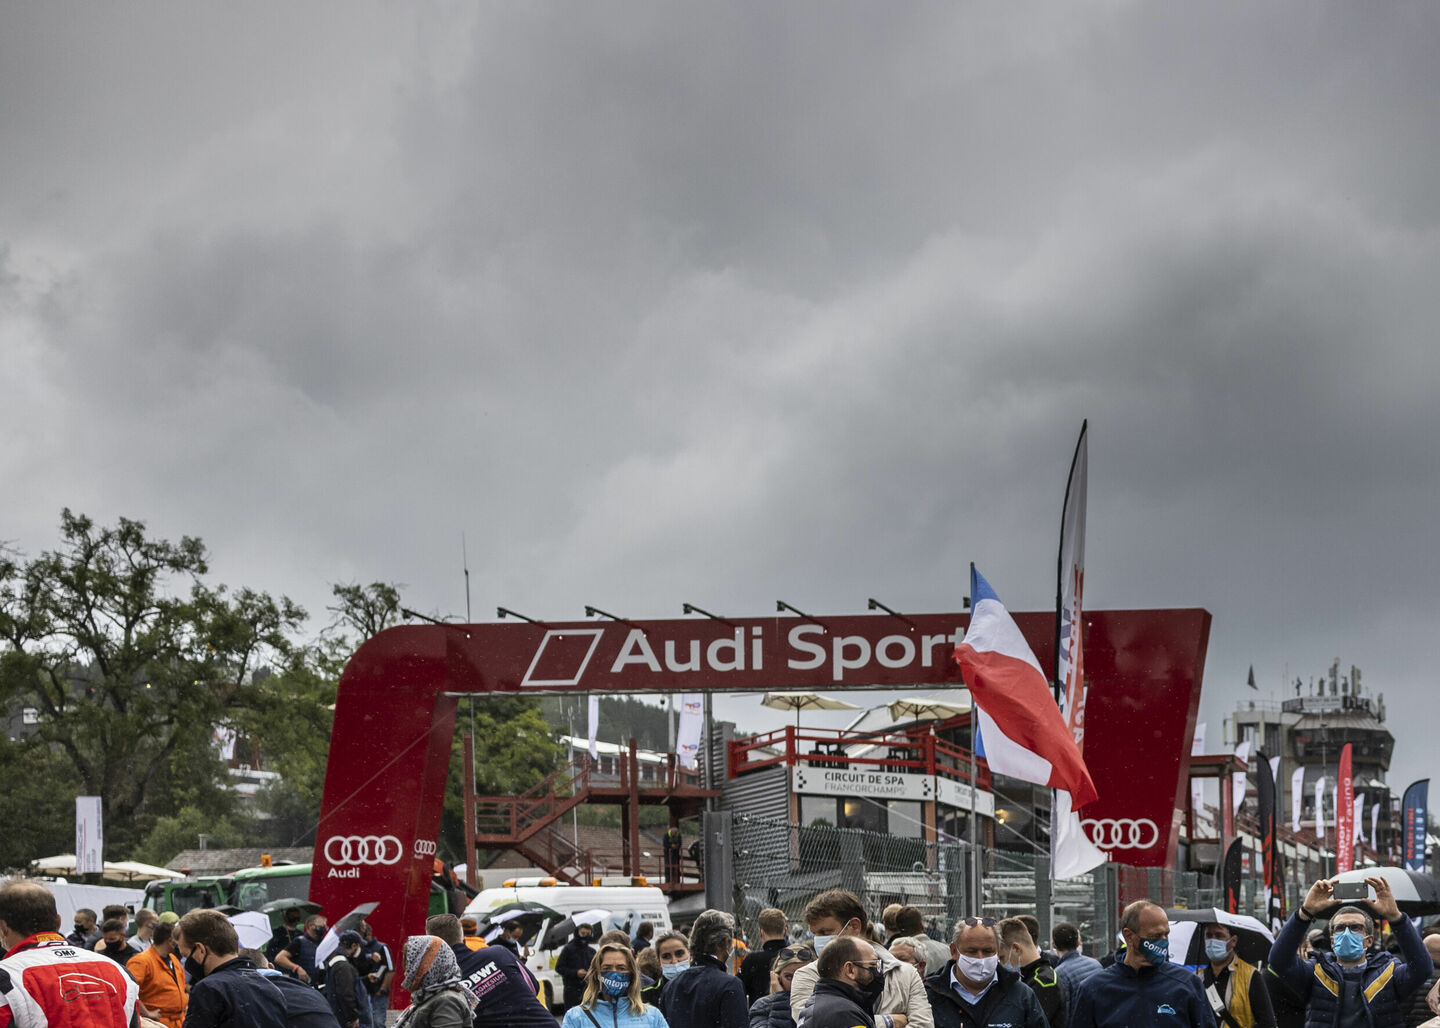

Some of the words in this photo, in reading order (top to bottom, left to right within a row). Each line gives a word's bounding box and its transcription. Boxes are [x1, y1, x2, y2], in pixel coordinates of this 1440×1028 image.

[610, 626, 763, 673] Audi
[825, 772, 865, 784] CIRCUIT
[868, 773, 881, 784] DE
[884, 775, 904, 786] SPA
[825, 783, 905, 796] FRANCORCHAMPS
[1407, 808, 1415, 859] MARTINI
[1415, 808, 1424, 860] RACING
[328, 867, 360, 878] Audi
[469, 961, 498, 984] BWT
[474, 972, 506, 995] AGNESIUM
